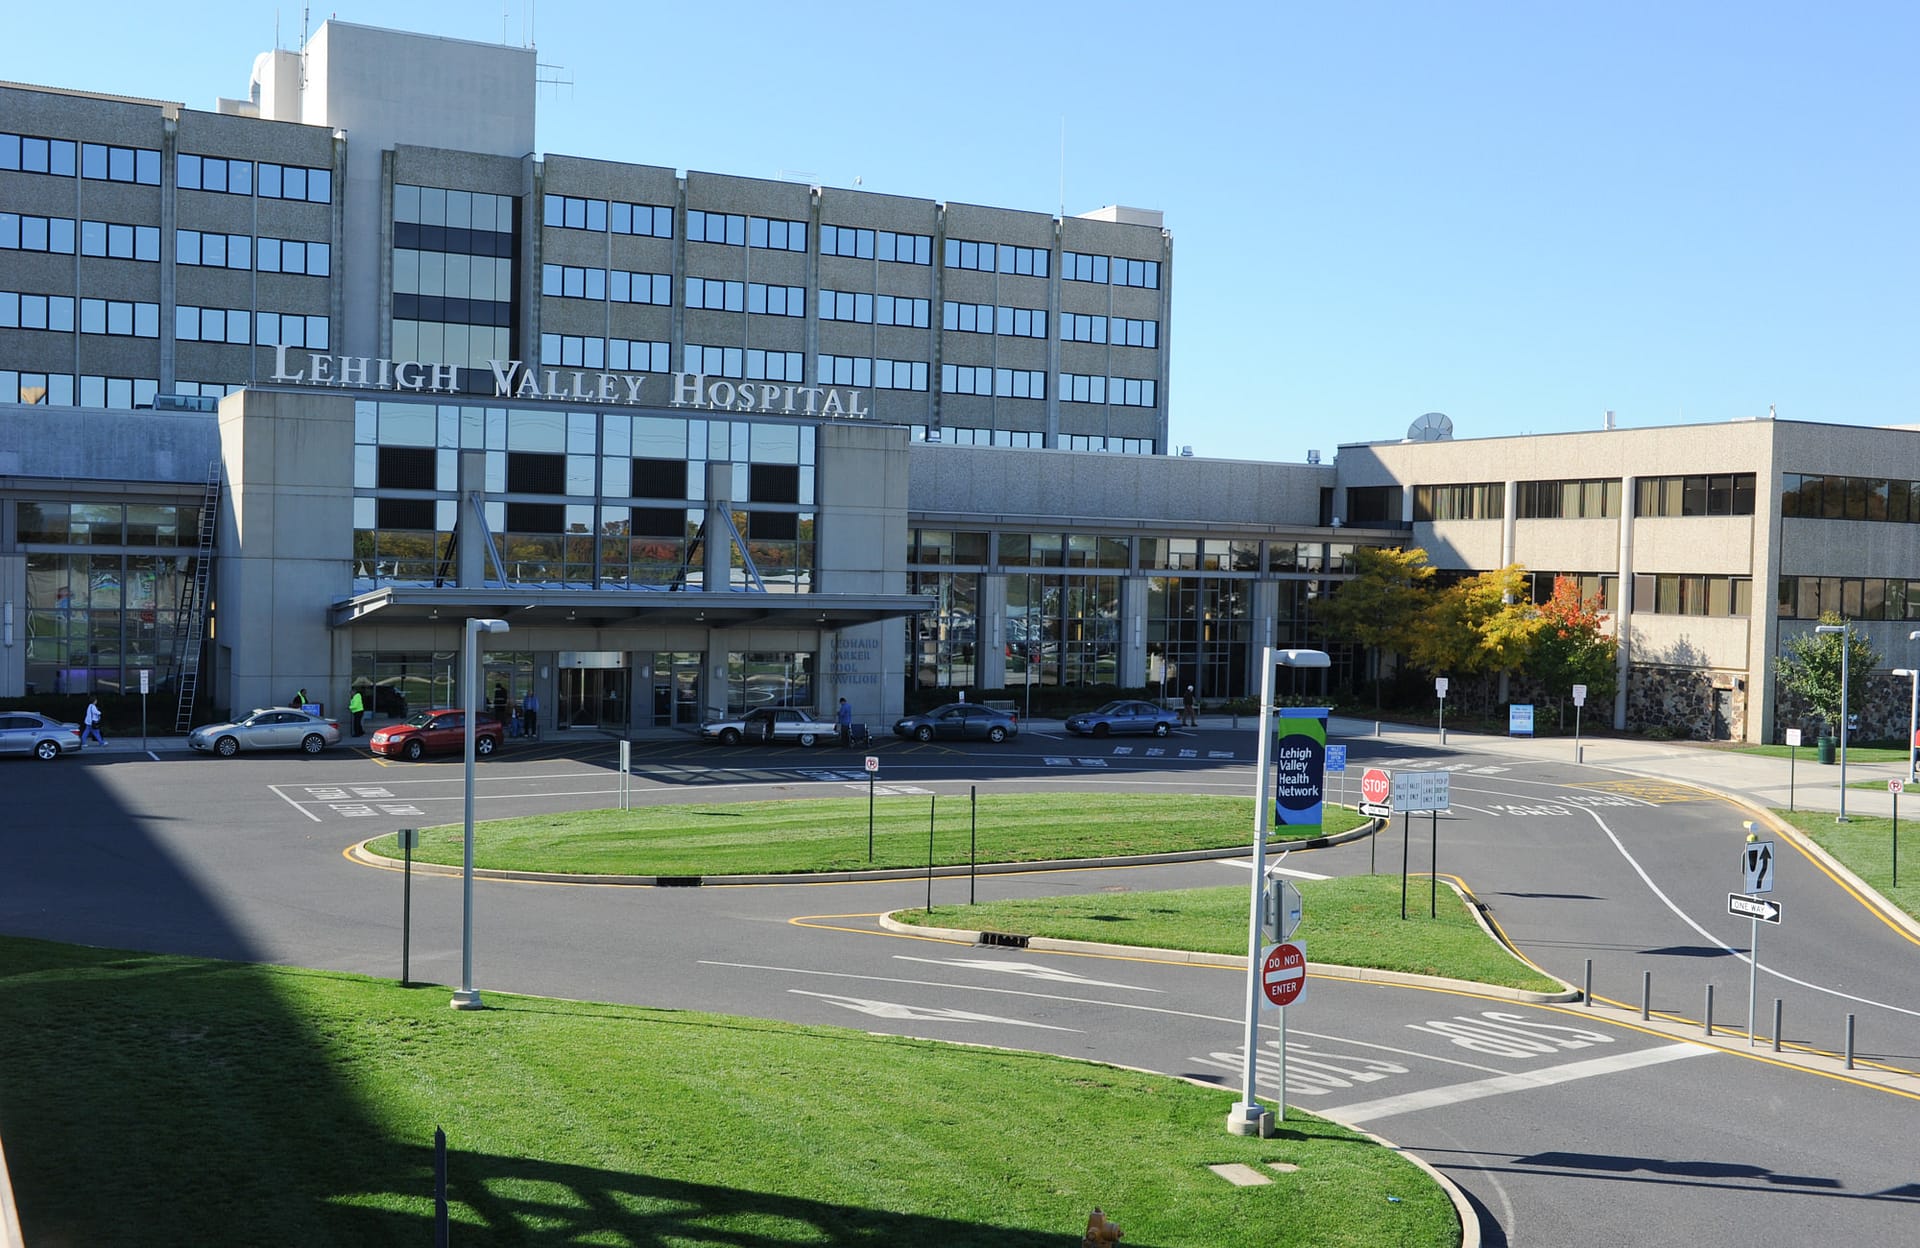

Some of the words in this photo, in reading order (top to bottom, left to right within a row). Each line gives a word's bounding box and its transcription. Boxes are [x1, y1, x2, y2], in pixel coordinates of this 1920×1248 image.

[269, 344, 460, 393] LEHIGH
[487, 359, 647, 405] VALLEY
[670, 371, 869, 418] HOSPITAL
[1280, 747, 1312, 761] Lehigh
[1280, 759, 1309, 773] Valley
[1279, 772, 1310, 785] Health
[1363, 778, 1387, 793] STOP
[1279, 785, 1319, 797] Network
[1734, 900, 1749, 911] ONE
[1751, 904, 1765, 914] WAY
[1269, 957, 1280, 969] DO
[1284, 954, 1300, 966] NOT
[1272, 982, 1297, 996] ENTER
